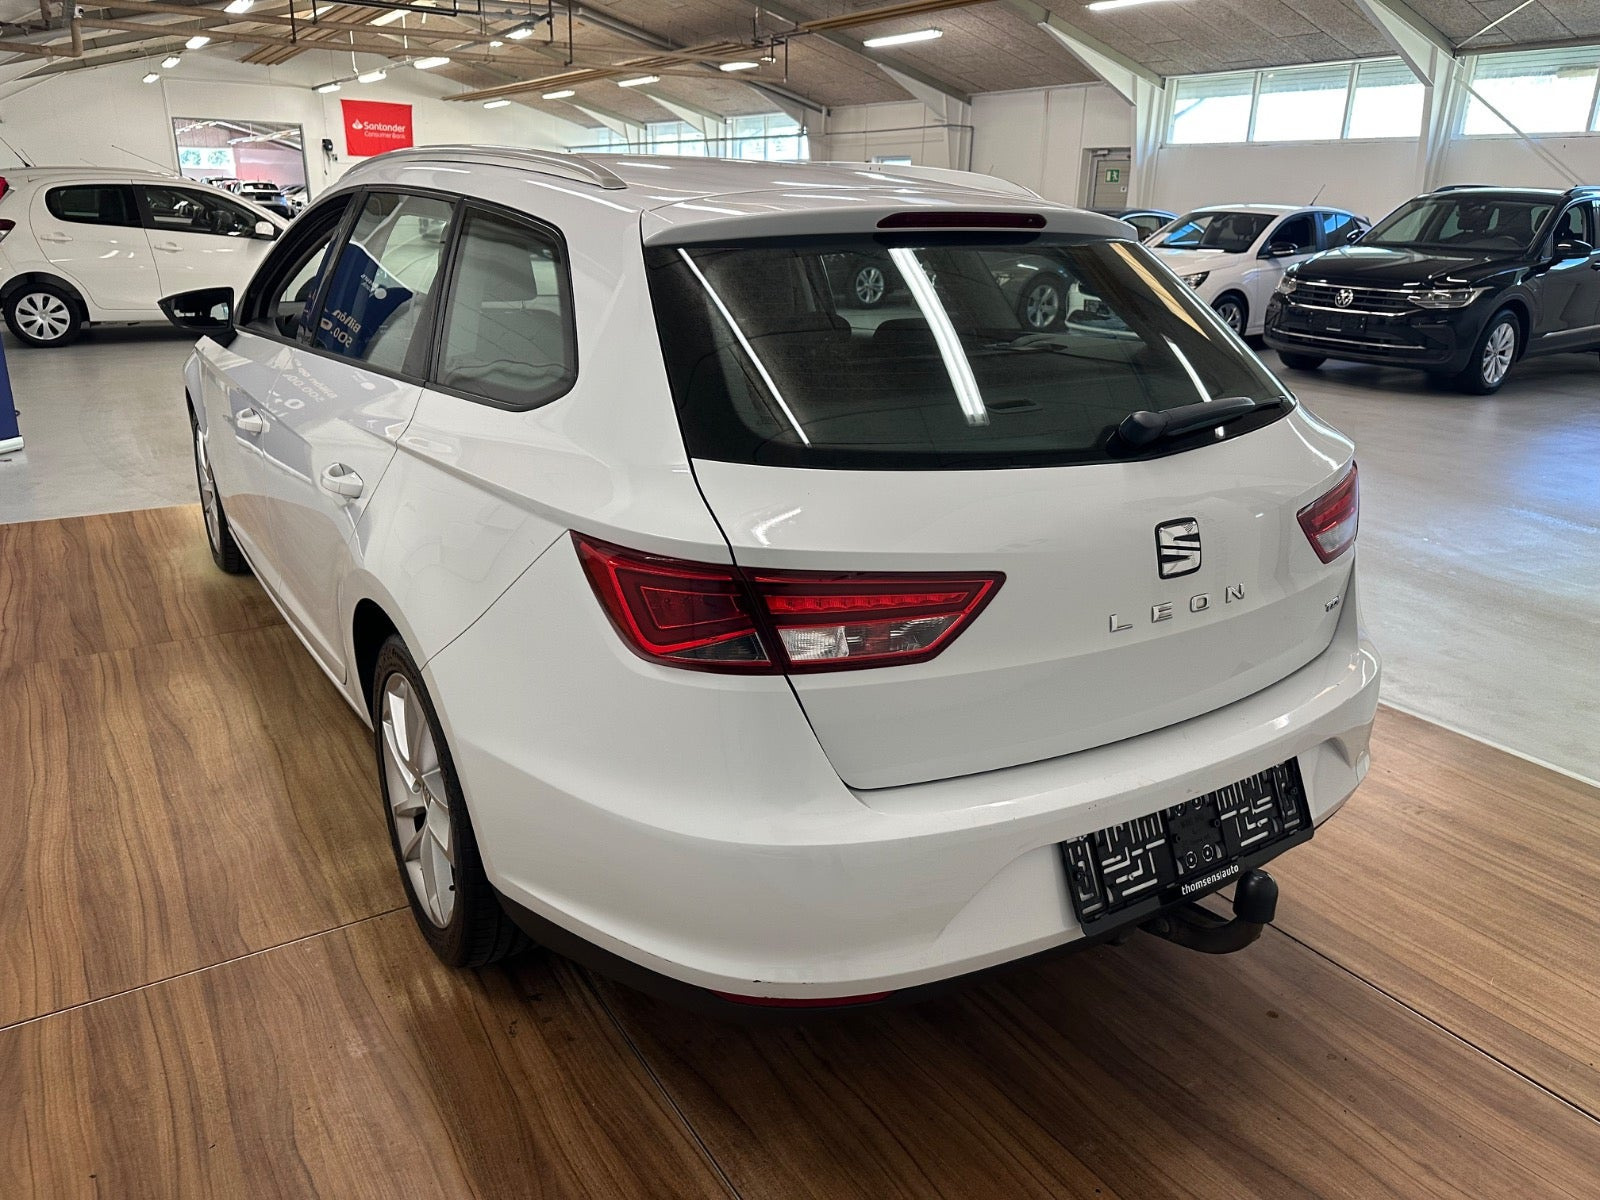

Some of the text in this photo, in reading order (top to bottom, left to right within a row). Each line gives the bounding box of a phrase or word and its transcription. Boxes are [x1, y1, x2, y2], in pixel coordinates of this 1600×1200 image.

[363, 121, 406, 133] Santander
[364, 130, 392, 138] Consumer
[1109, 583, 1245, 633] LEON
